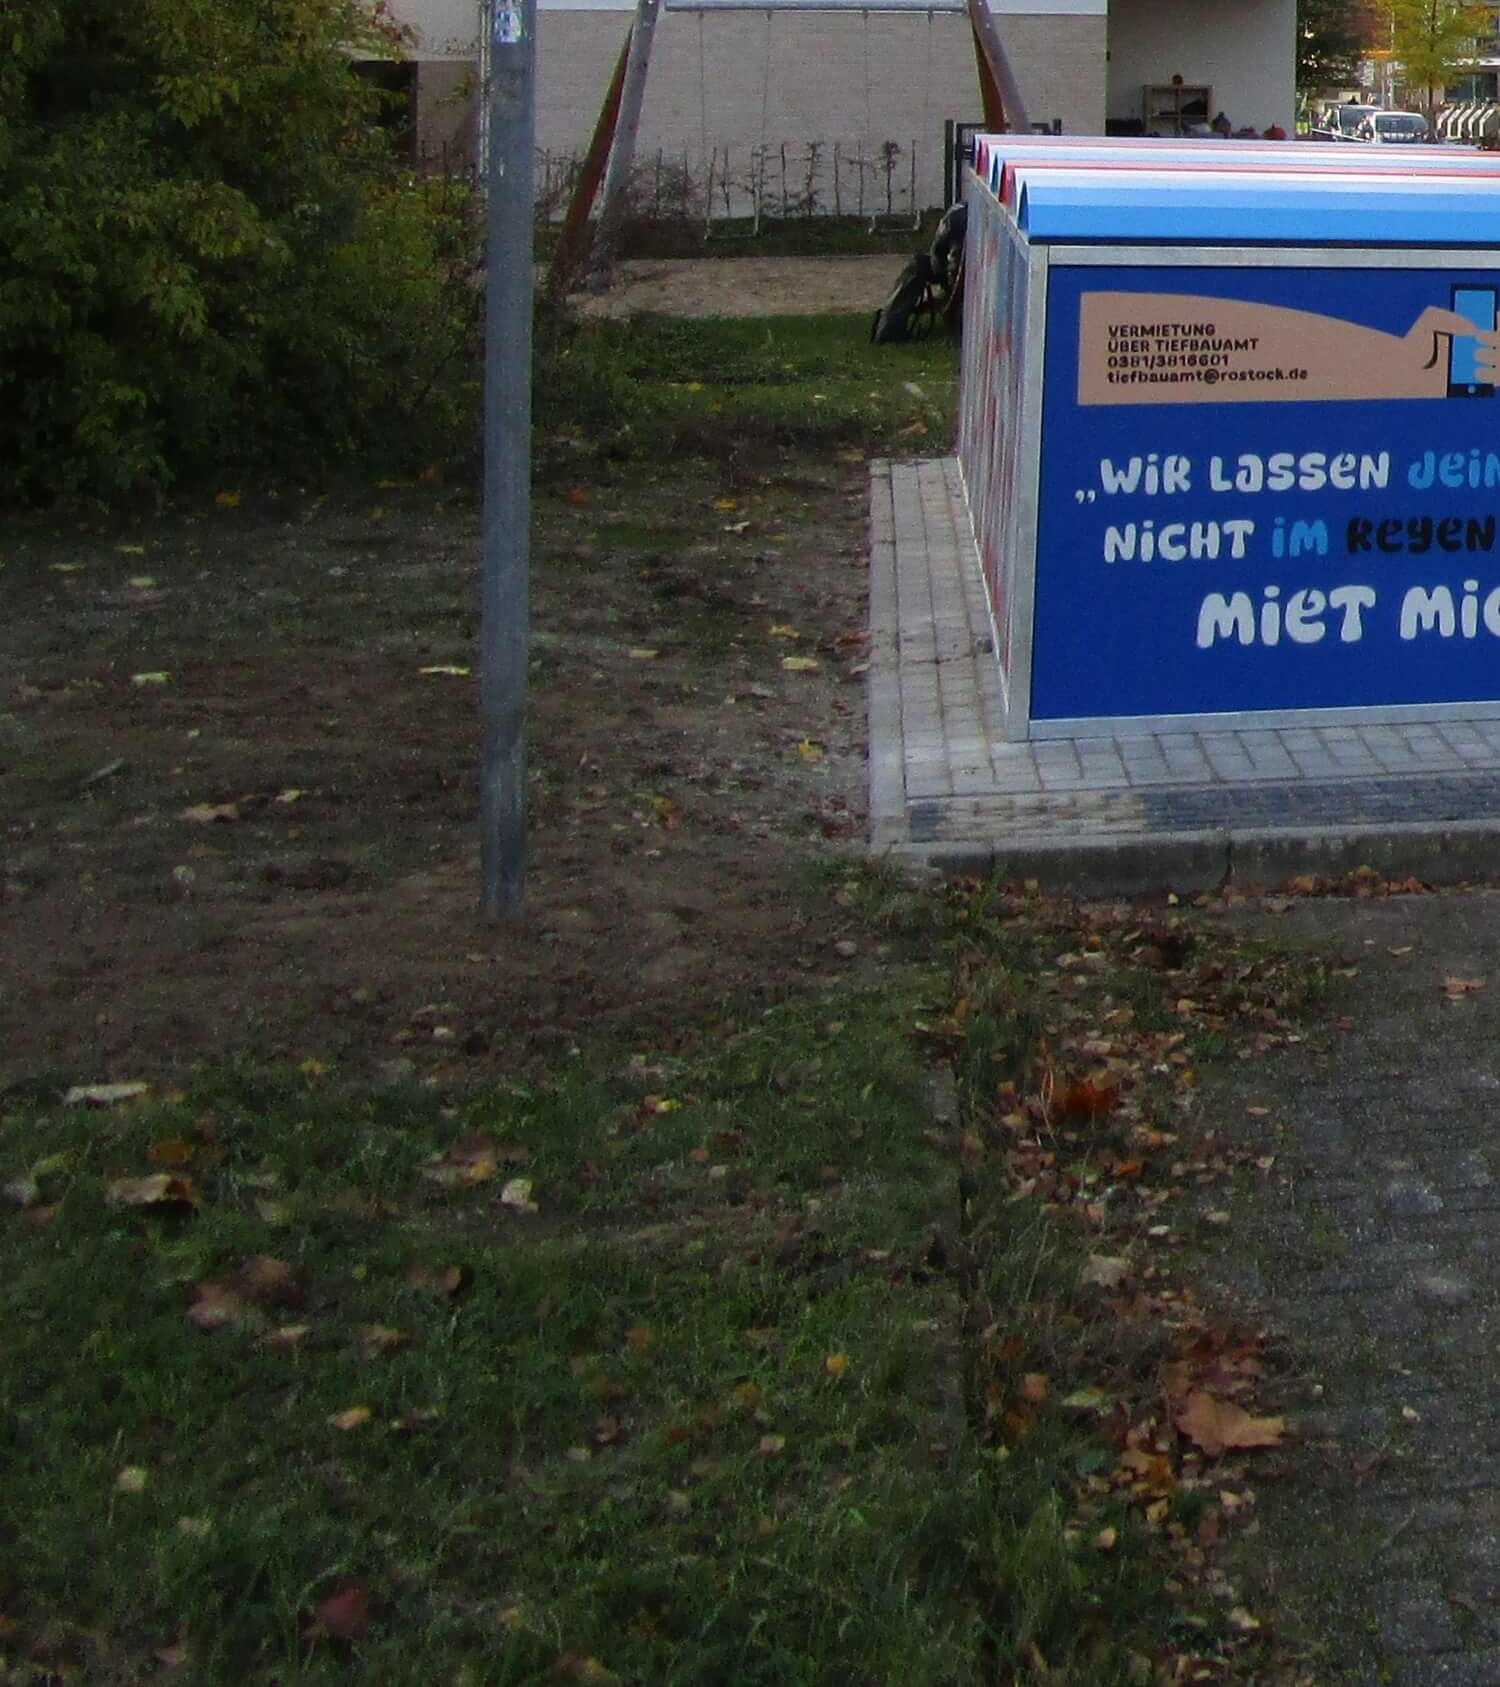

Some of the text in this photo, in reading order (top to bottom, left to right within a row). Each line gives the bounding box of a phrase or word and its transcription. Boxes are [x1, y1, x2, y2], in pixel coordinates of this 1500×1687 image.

[1108, 324, 1216, 338] VERMIETUNG
[1108, 338, 1259, 353] ÜBER TIEFBAUAMT
[1108, 354, 1229, 369] 0381/3816601
[1108, 368, 1308, 384] tiefbauamt@rostock.de
